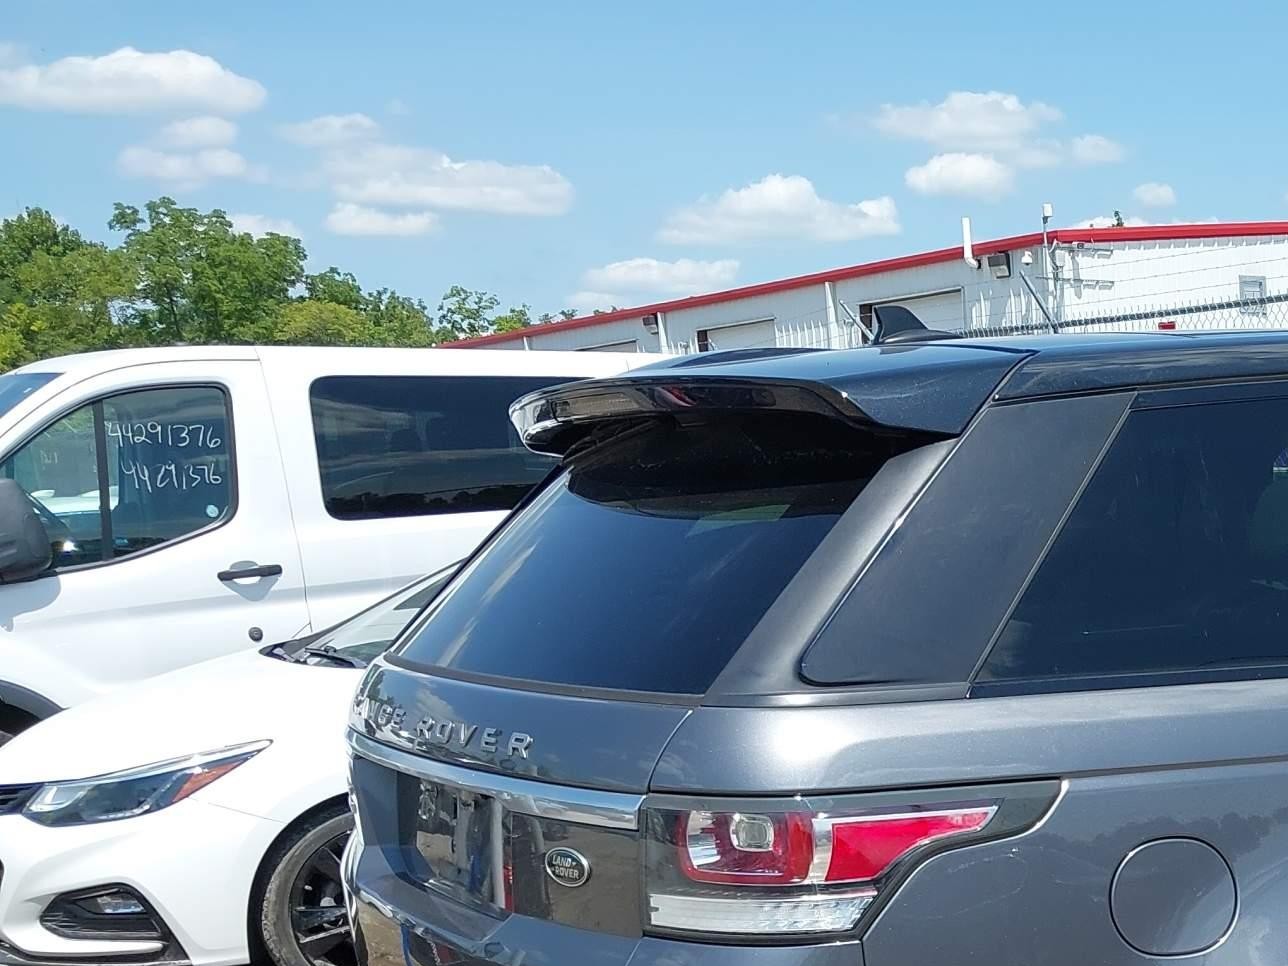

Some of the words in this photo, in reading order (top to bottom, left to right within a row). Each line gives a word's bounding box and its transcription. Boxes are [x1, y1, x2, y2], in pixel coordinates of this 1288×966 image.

[104, 421, 221, 448] 44291376
[121, 460, 222, 493] 44291376
[416, 715, 535, 760] ROVER
[552, 855, 572, 867] LAND
[554, 866, 580, 880] ROVER
